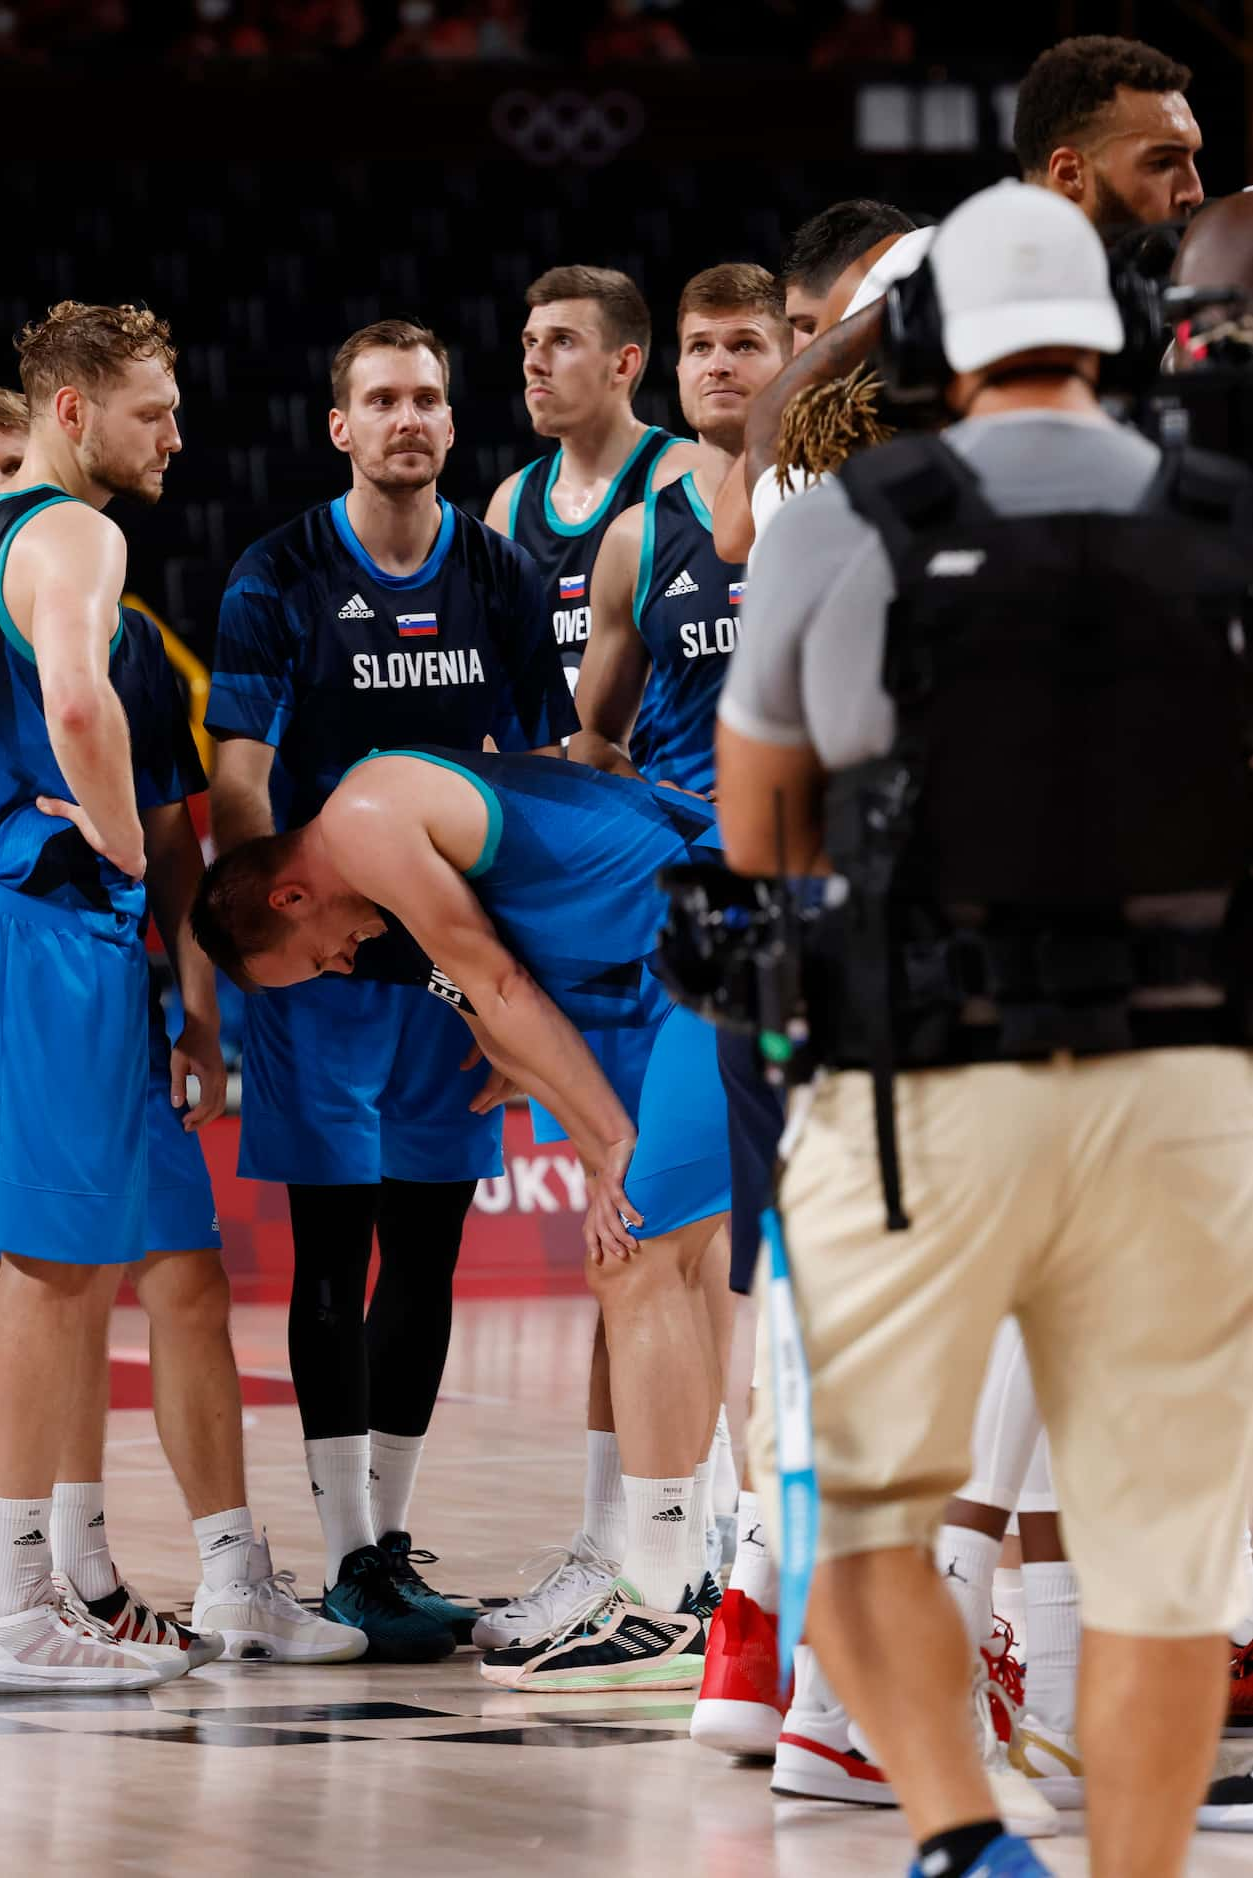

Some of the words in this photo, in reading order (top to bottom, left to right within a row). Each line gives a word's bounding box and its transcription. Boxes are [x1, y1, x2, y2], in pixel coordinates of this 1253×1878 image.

[664, 583, 700, 598] adidas
[338, 609, 375, 619] adidas
[352, 649, 486, 690] SLOVENIA
